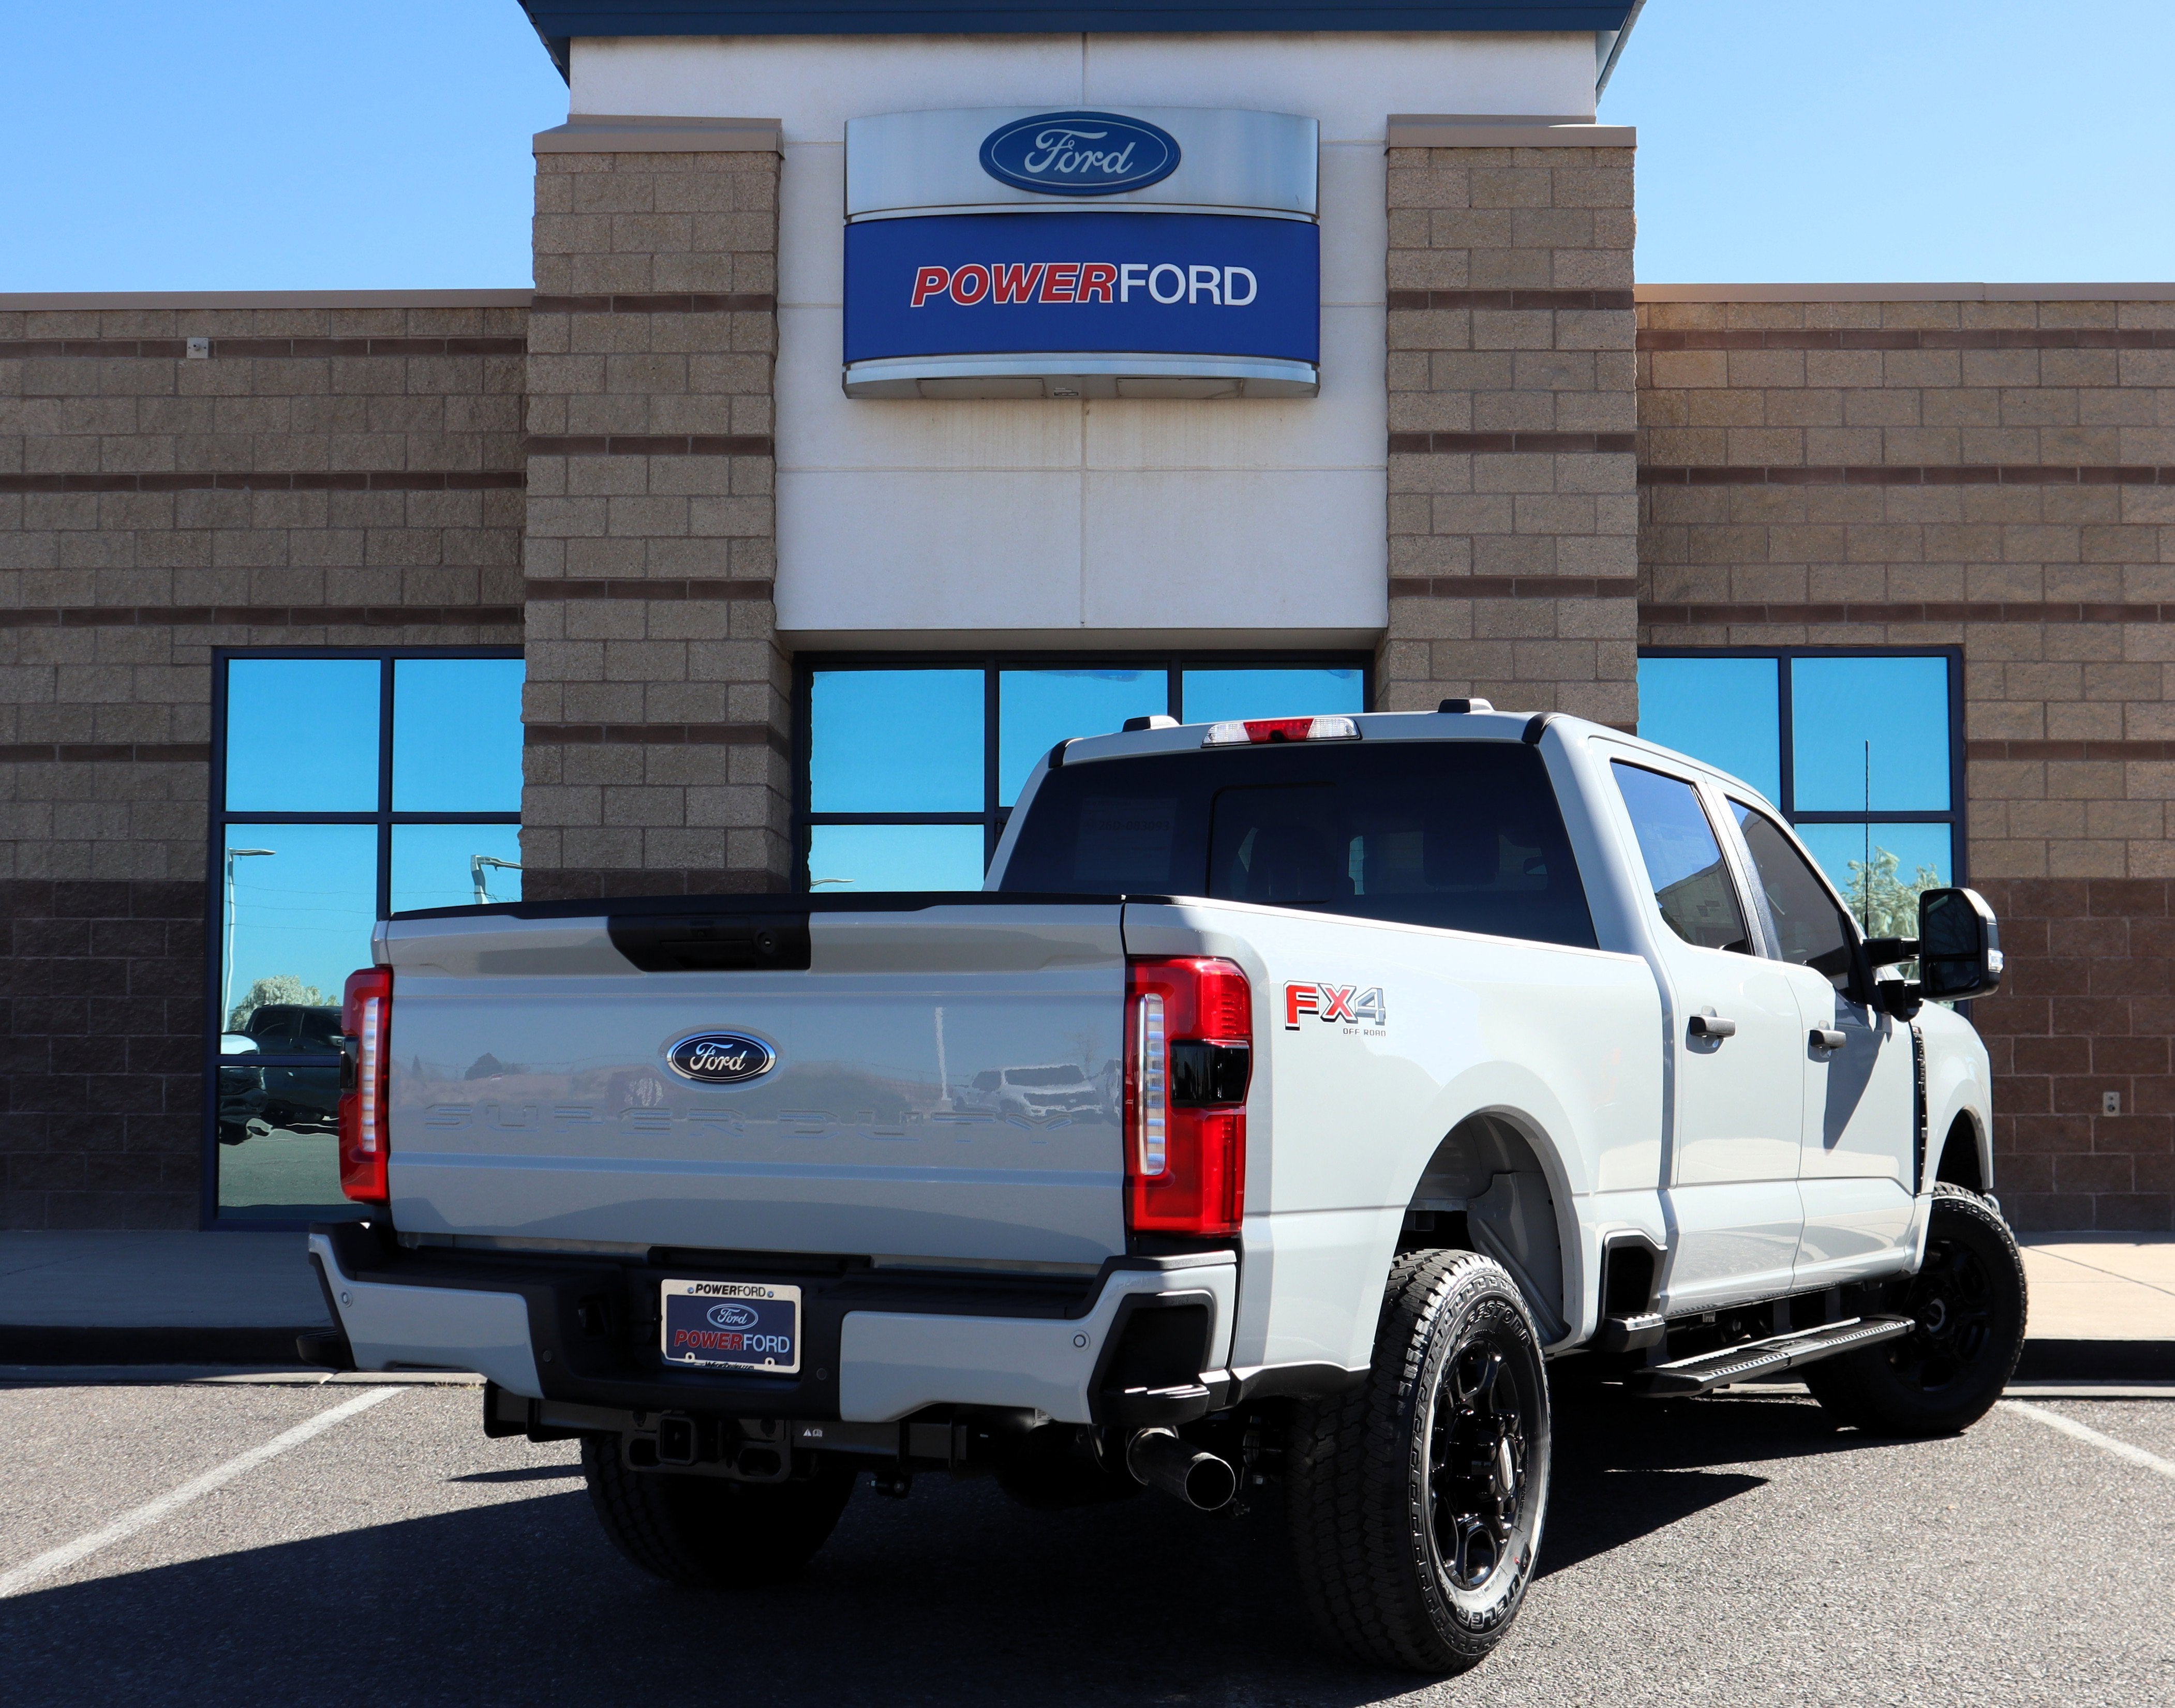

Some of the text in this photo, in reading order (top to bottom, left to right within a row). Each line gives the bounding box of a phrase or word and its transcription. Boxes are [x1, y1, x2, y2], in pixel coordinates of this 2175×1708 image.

[1024, 129, 1138, 176] Ford
[1284, 980, 1387, 1031] FX4
[1363, 1029, 1386, 1037] ROAD
[689, 1042, 748, 1072] Ford
[425, 1104, 745, 1137] SUPER
[717, 1308, 748, 1325] Ford
